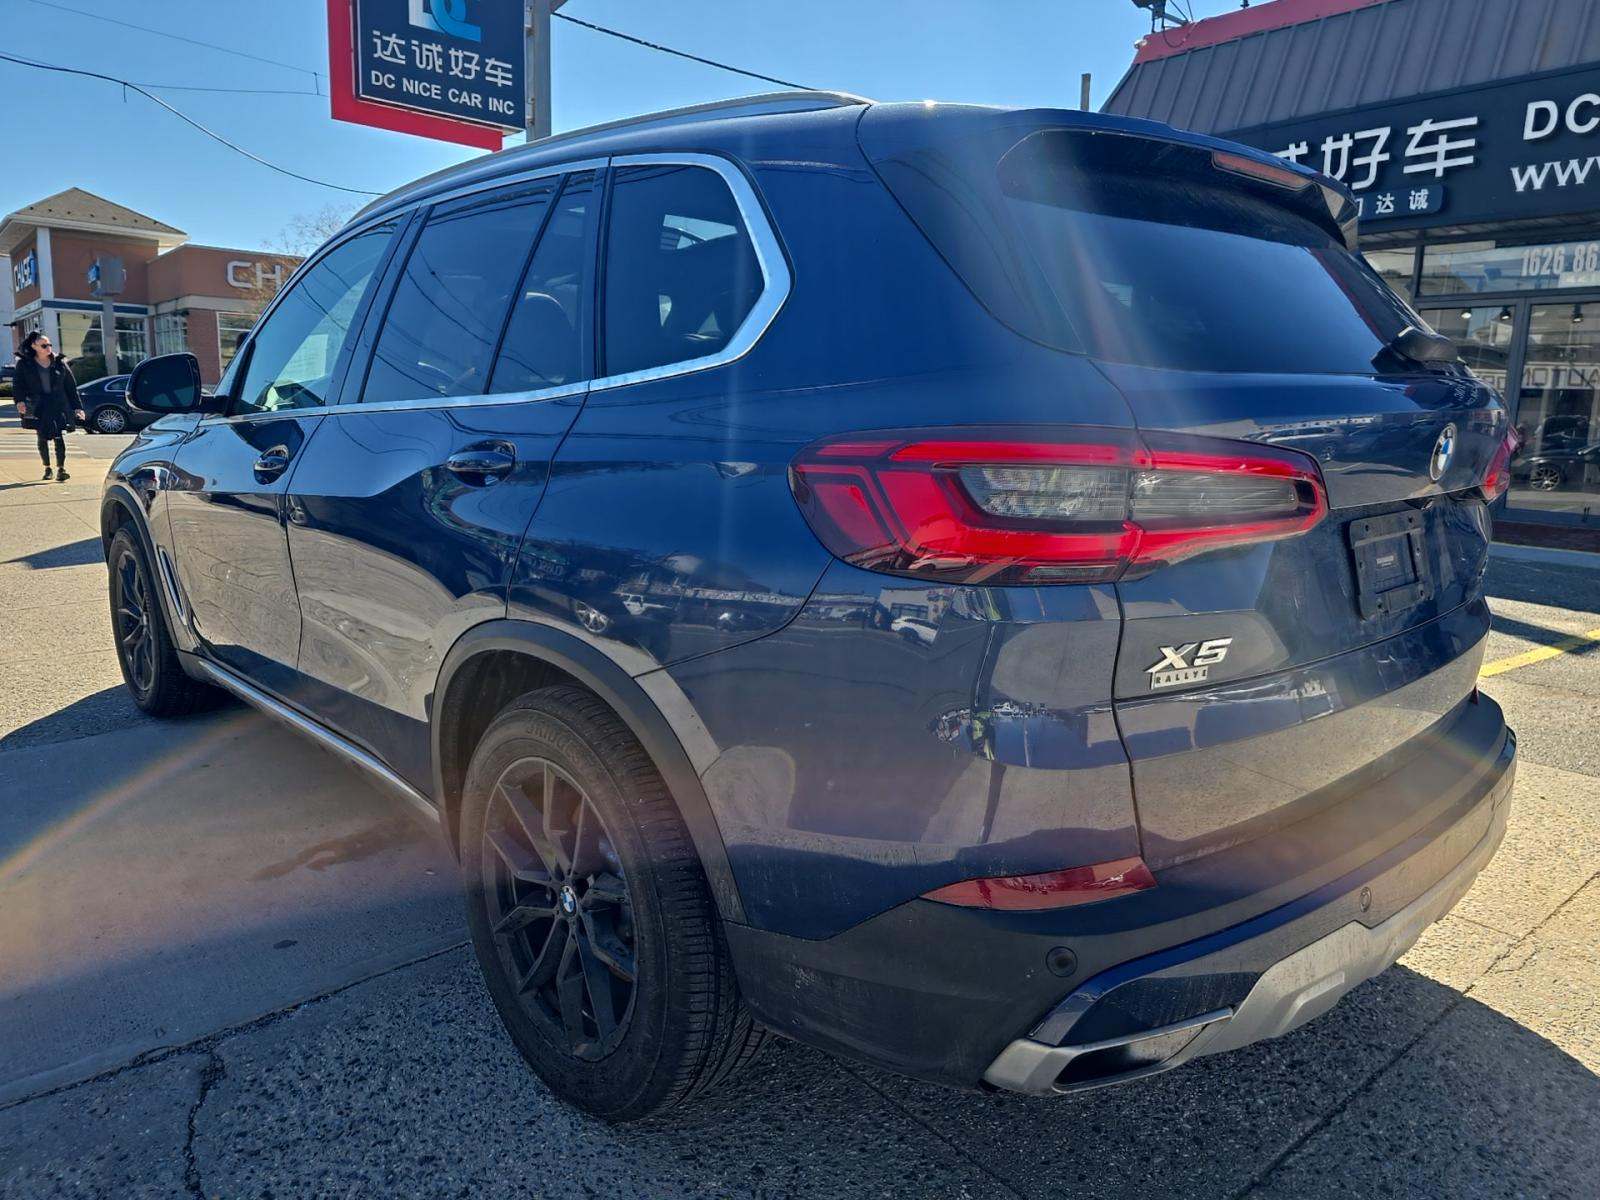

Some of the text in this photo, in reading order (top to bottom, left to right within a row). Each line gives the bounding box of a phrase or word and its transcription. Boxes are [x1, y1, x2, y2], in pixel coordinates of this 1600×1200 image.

[372, 30, 513, 87] 达诚好车
[371, 70, 514, 115] DC NICE CAR INC
[1522, 92, 1600, 141] DC
[227, 260, 290, 291] CH
[1521, 242, 1600, 277] 1626 86
[1144, 638, 1233, 673] X5
